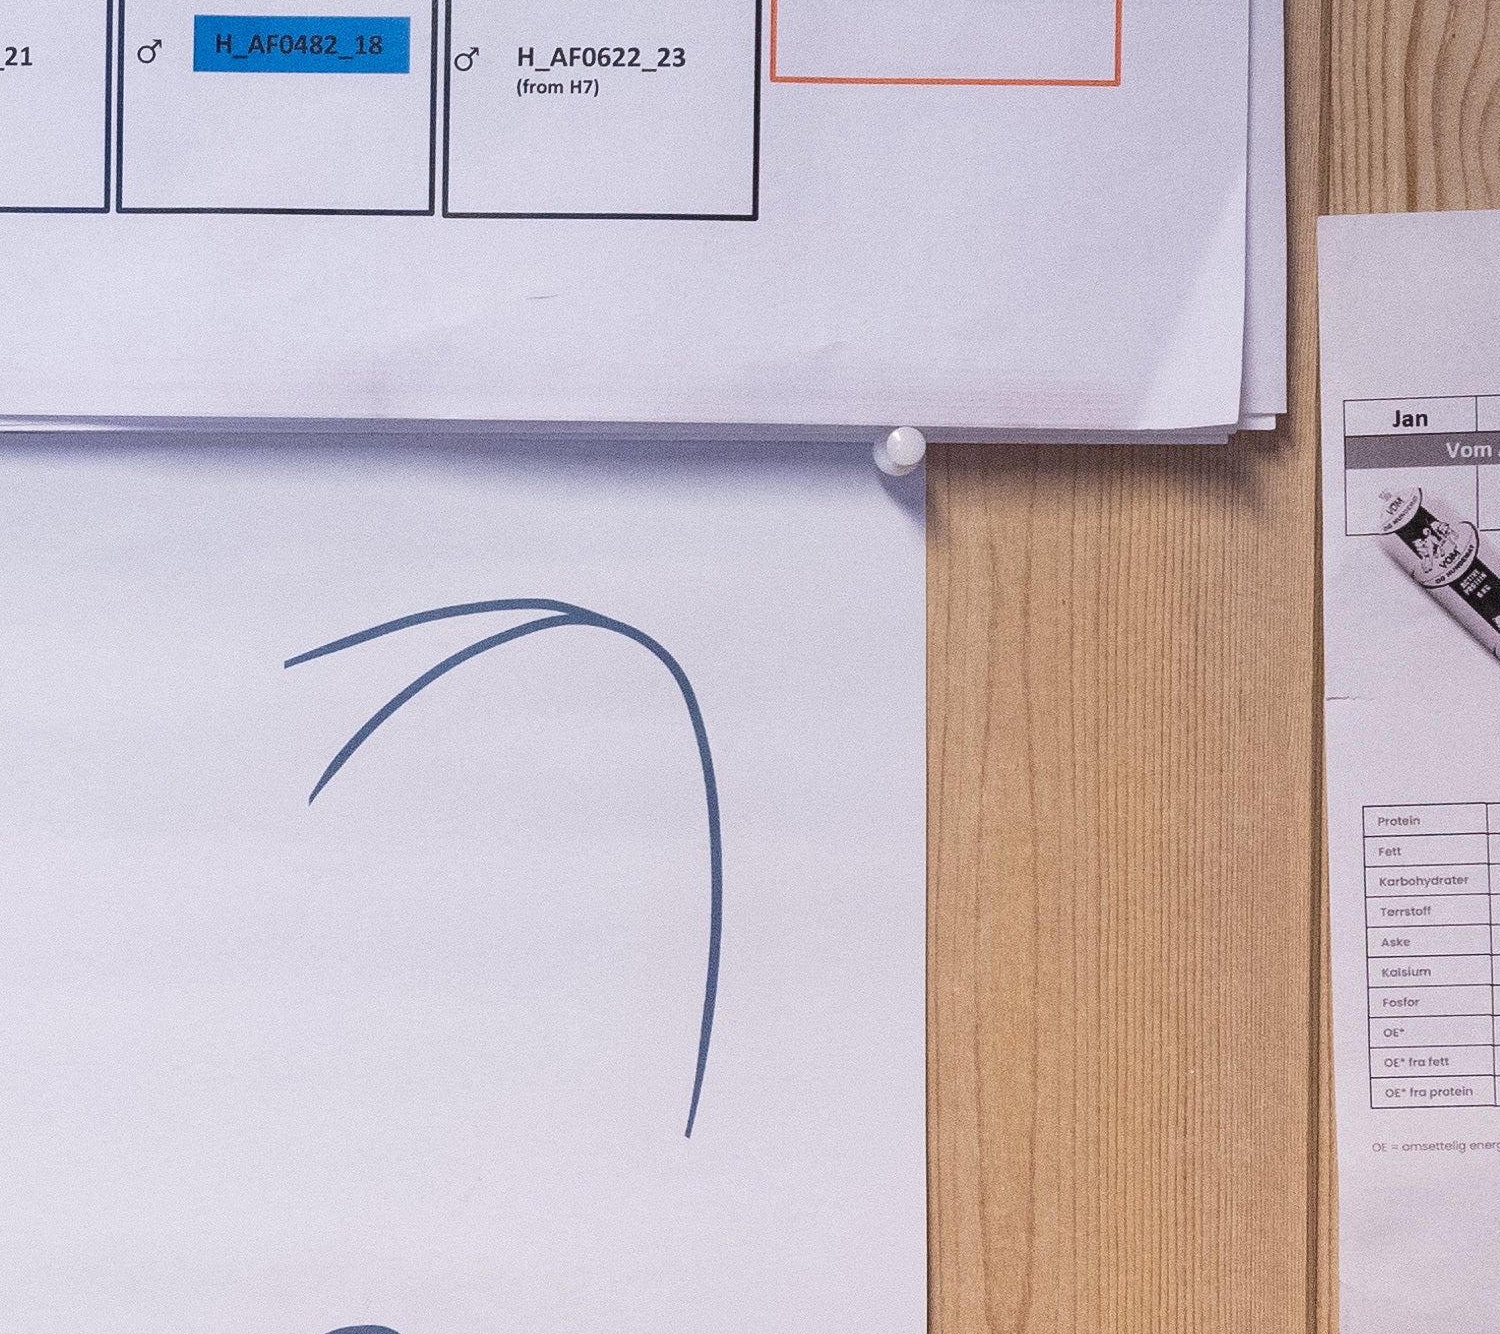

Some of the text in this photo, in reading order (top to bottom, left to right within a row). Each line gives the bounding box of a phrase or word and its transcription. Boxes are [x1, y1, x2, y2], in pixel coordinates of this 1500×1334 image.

[215, 33, 383, 60] H_AF0482_18
[517, 46, 686, 73] H_AF0622_23
[1392, 409, 1428, 428] Jan
[1445, 442, 1493, 459] Vom
[1379, 875, 1469, 888] Karbohydrater
